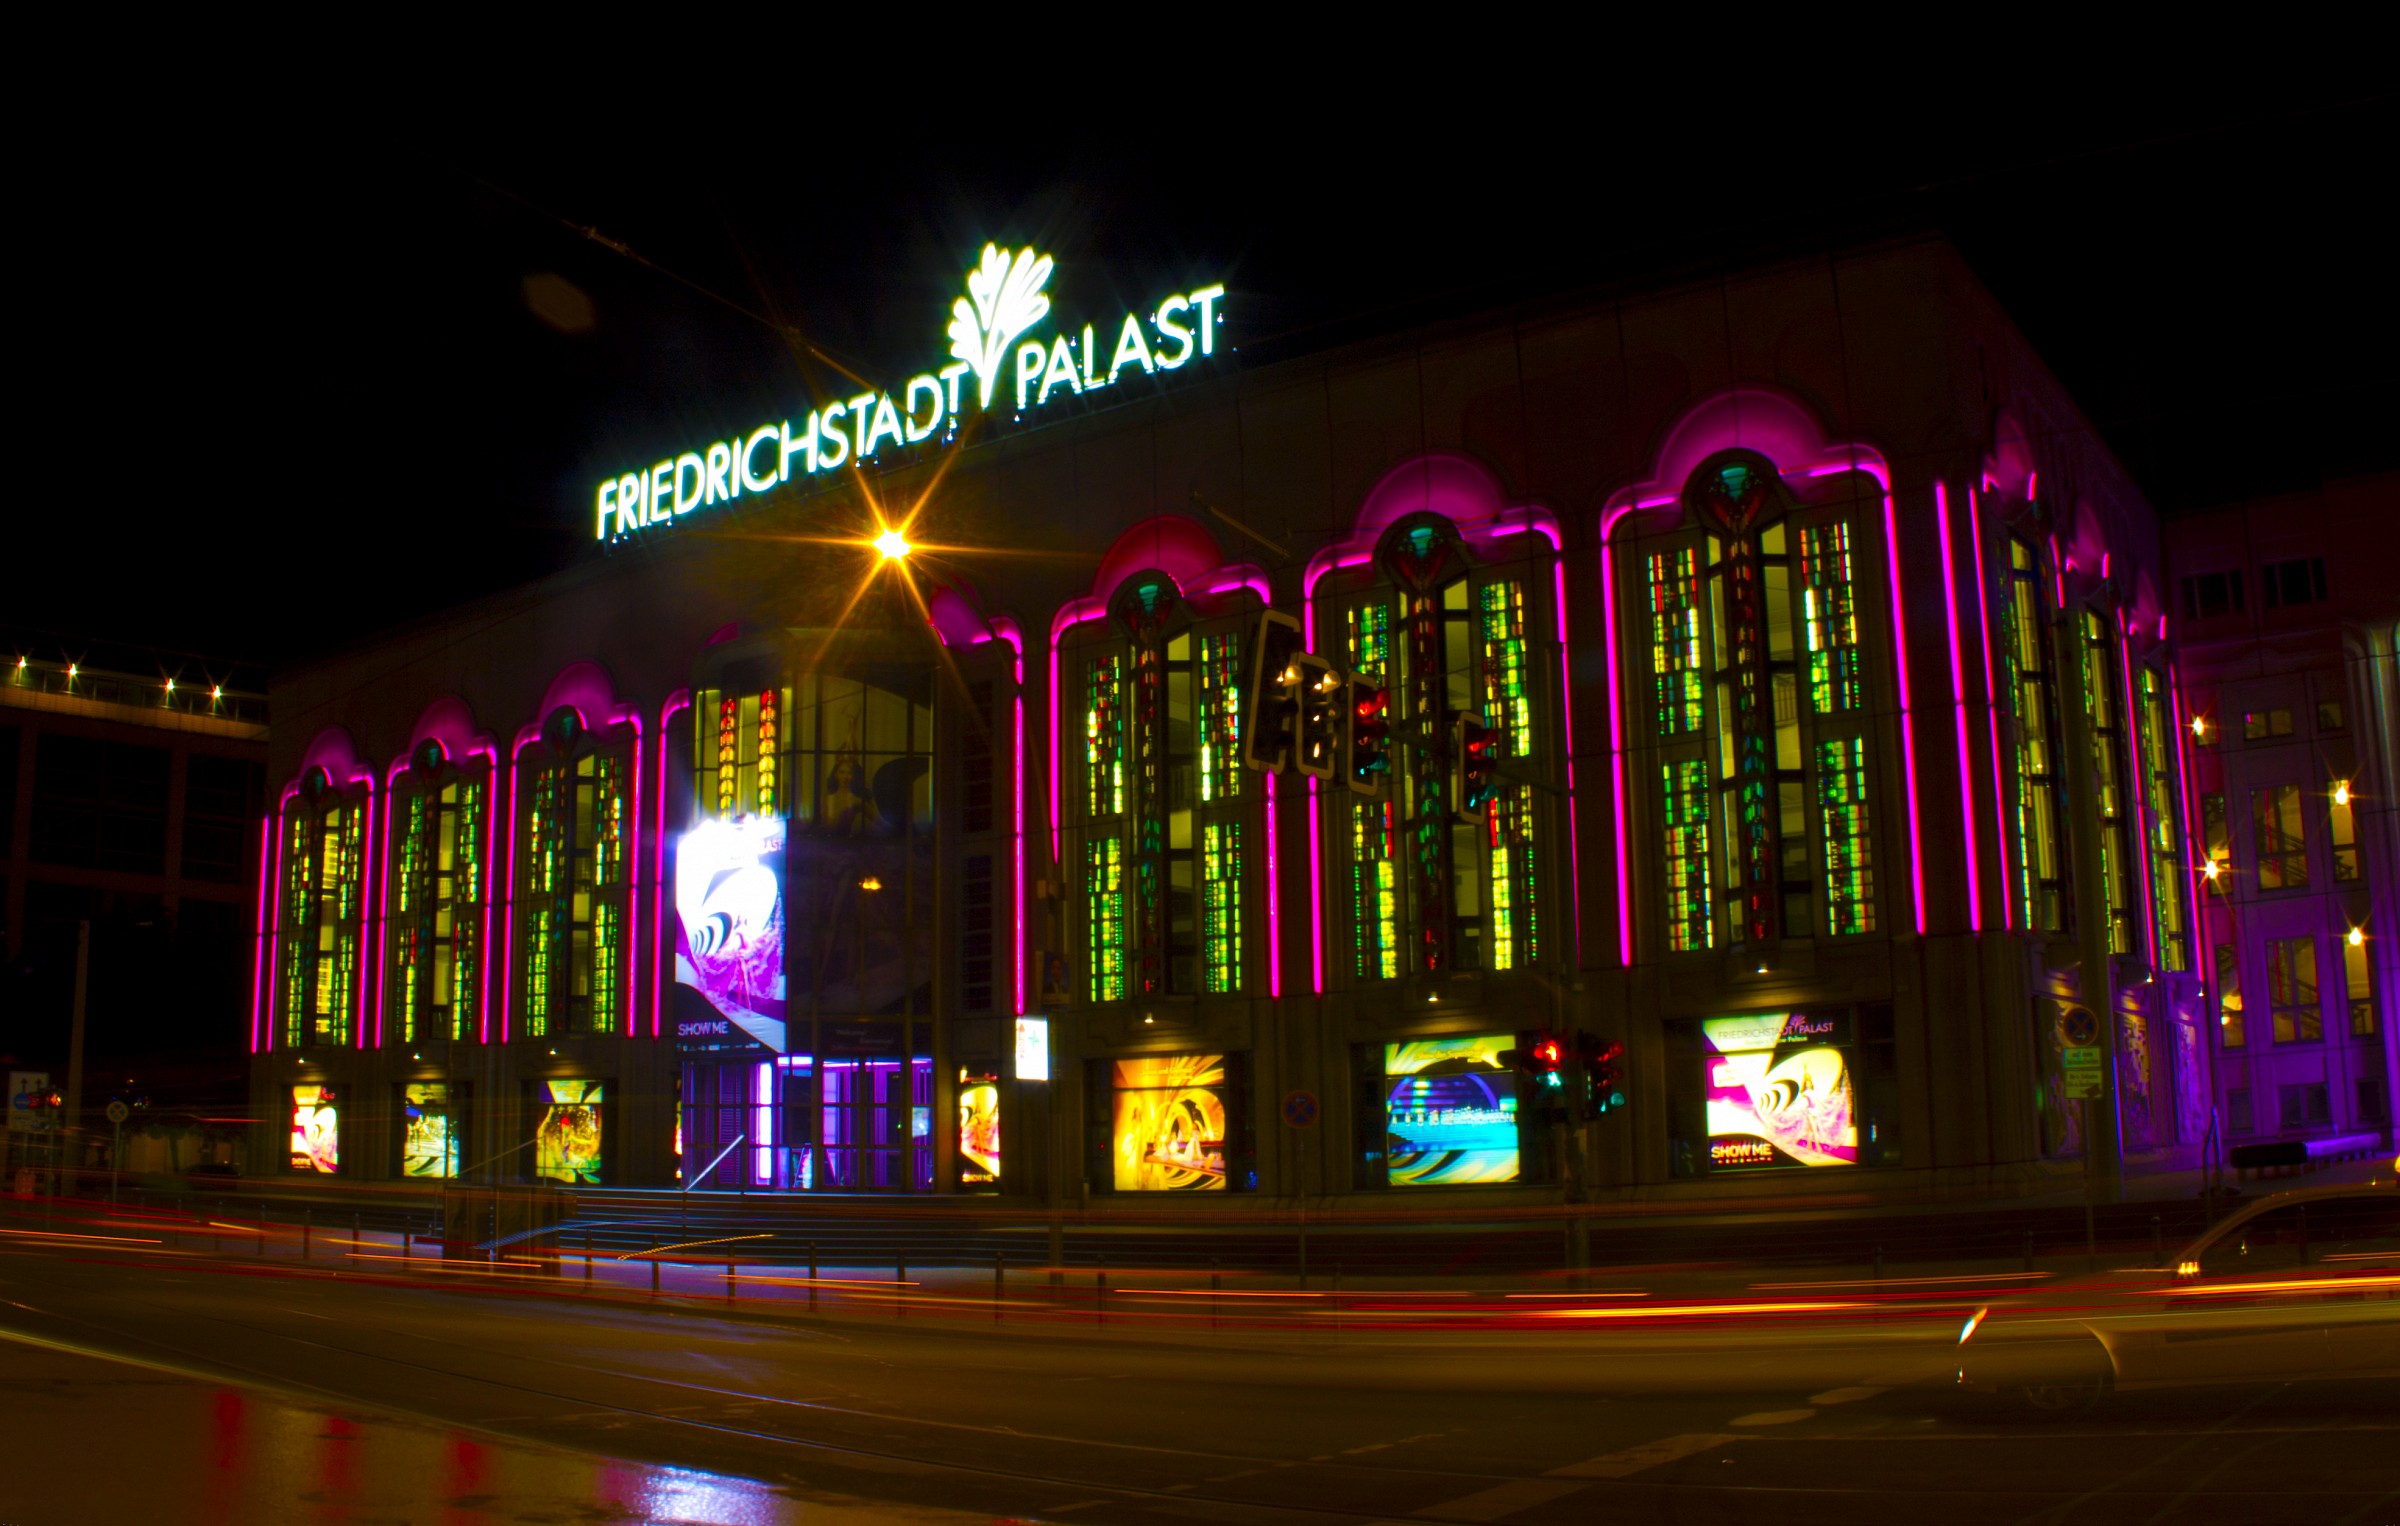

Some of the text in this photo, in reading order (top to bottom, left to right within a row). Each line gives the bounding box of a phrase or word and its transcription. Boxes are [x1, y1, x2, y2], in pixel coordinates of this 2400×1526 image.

[597, 283, 1225, 540] FRIEDRICHSTADT PALAST
[678, 1021, 729, 1036] SHOW ME
[1799, 1022, 1834, 1034] PALAST
[1711, 1143, 1771, 1158] SHOW ME
